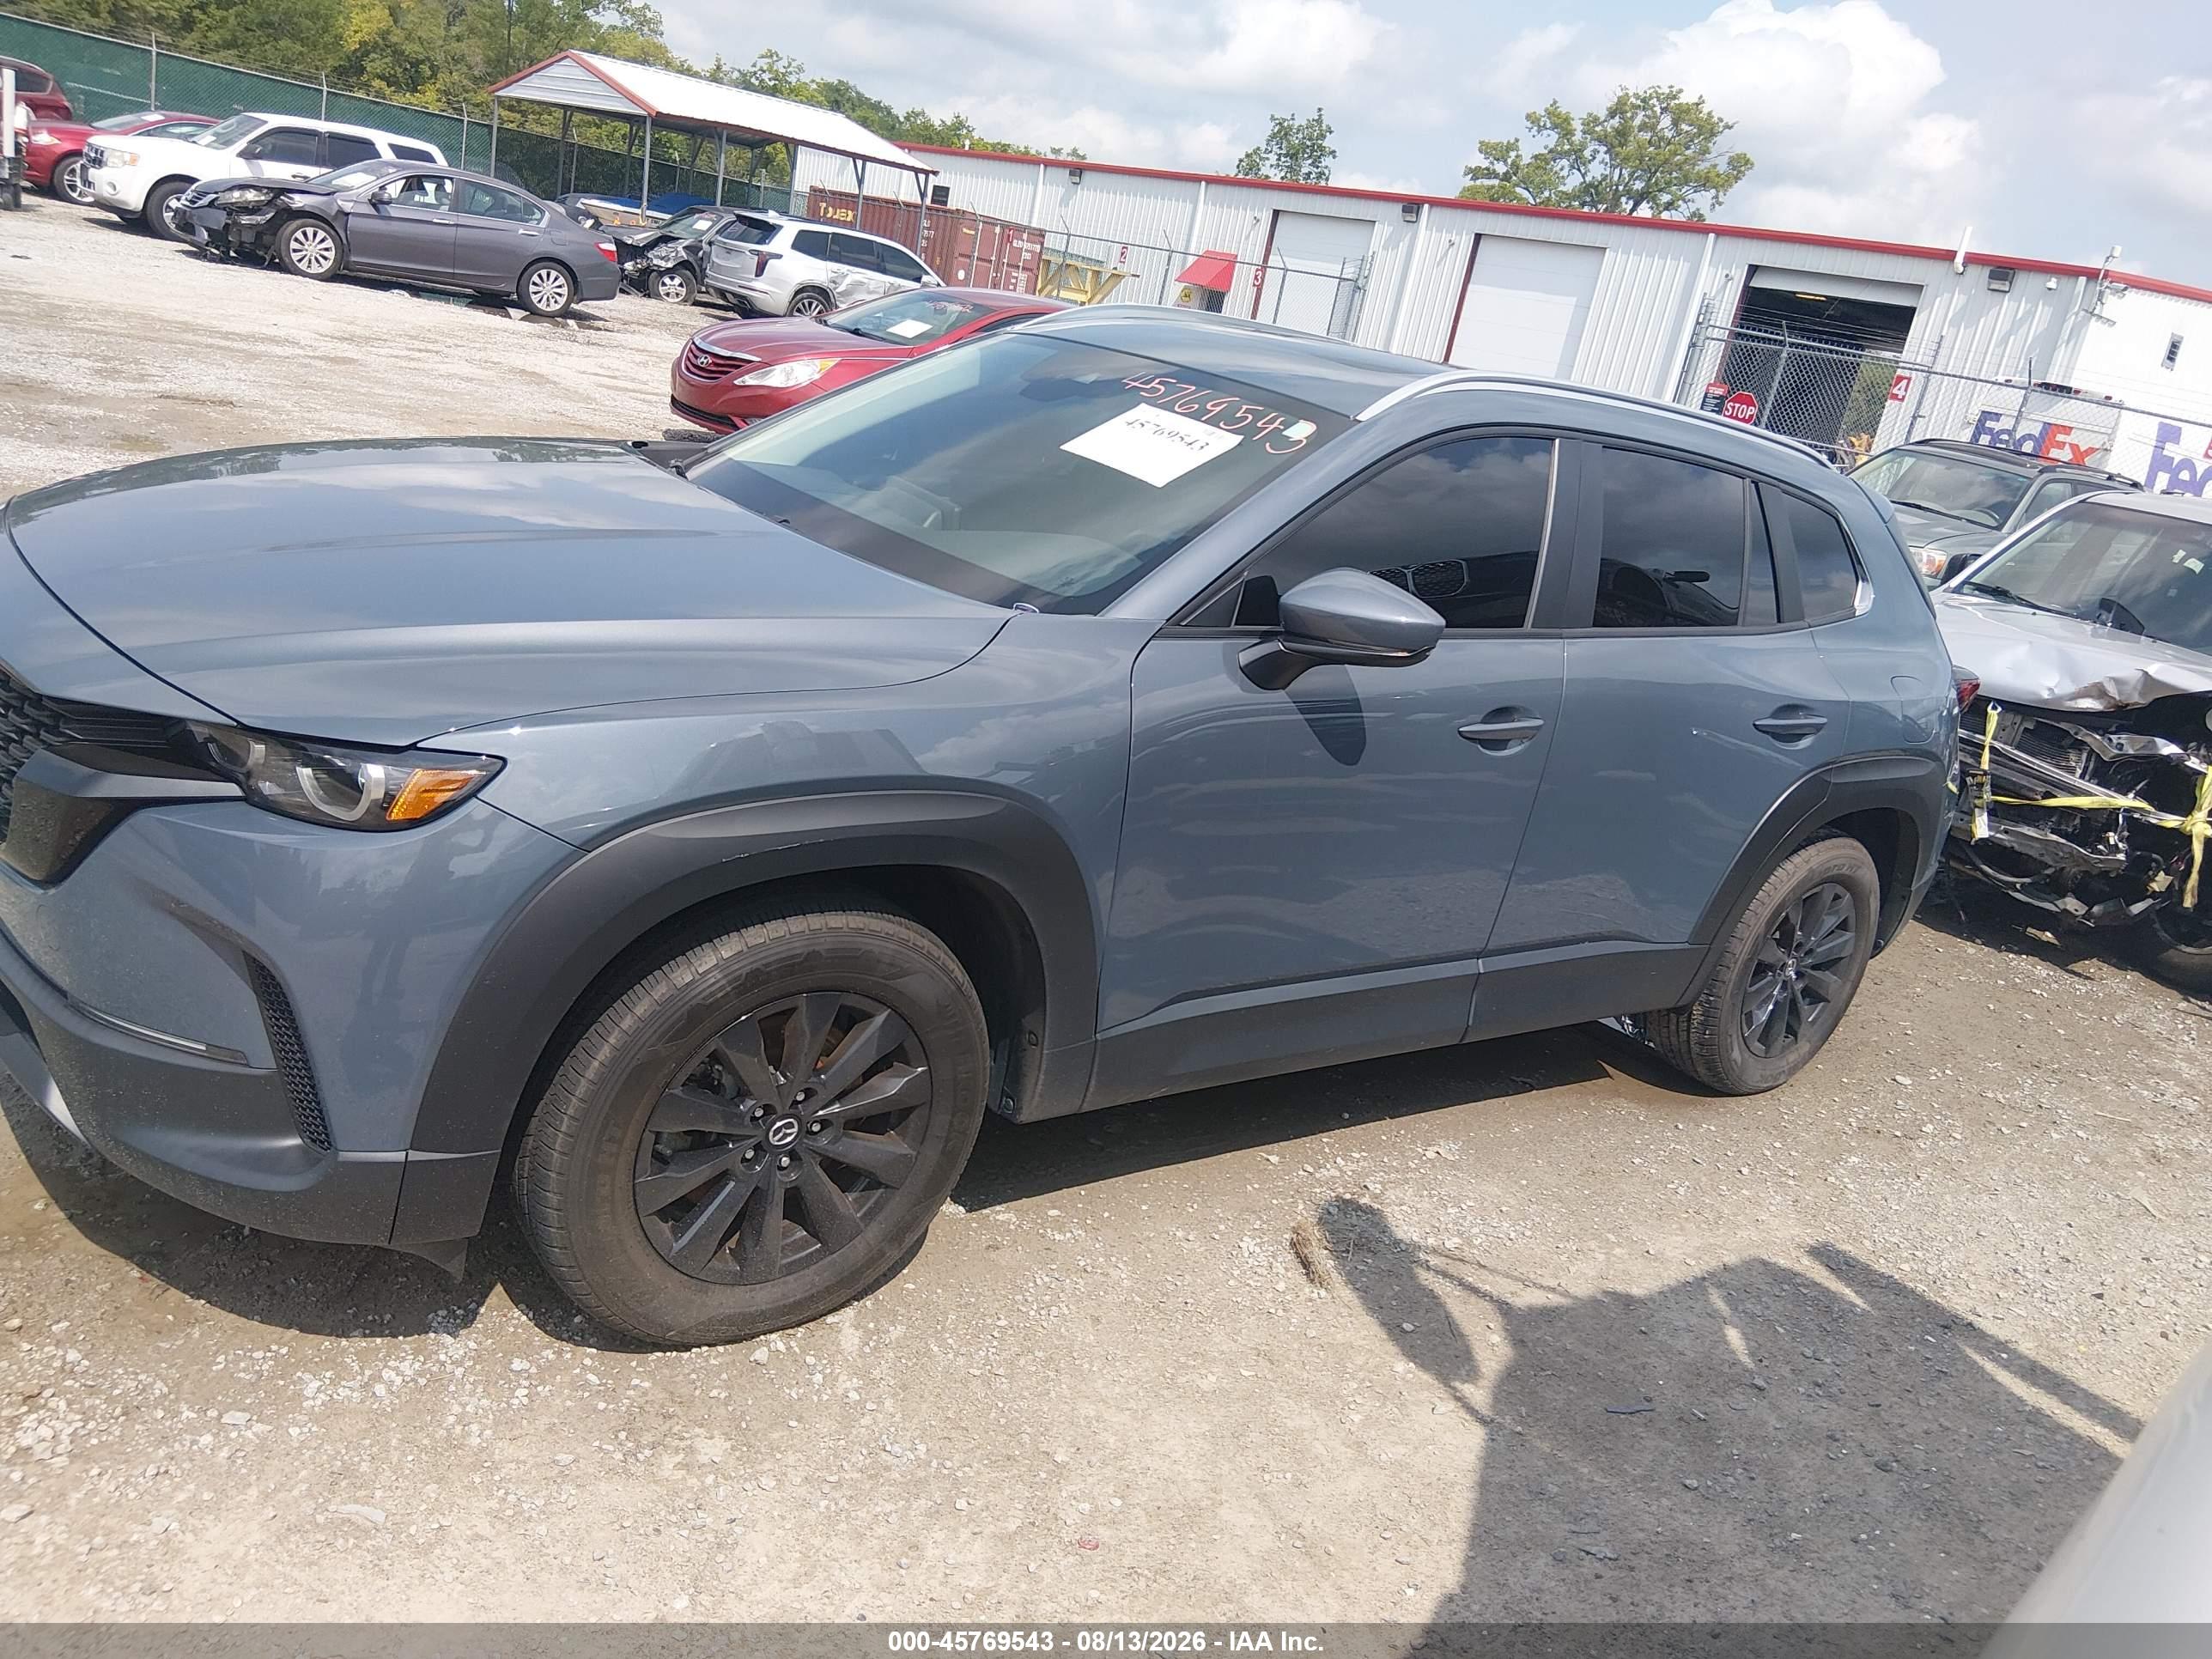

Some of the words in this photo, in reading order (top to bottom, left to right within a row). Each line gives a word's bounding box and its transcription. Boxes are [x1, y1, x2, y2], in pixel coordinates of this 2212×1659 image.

[1254, 270, 1262, 286] 3
[1892, 379, 1908, 399] 4
[1121, 371, 1318, 455] 45769543
[1724, 402, 1755, 420] STOP
[1969, 410, 2100, 466] FedEx
